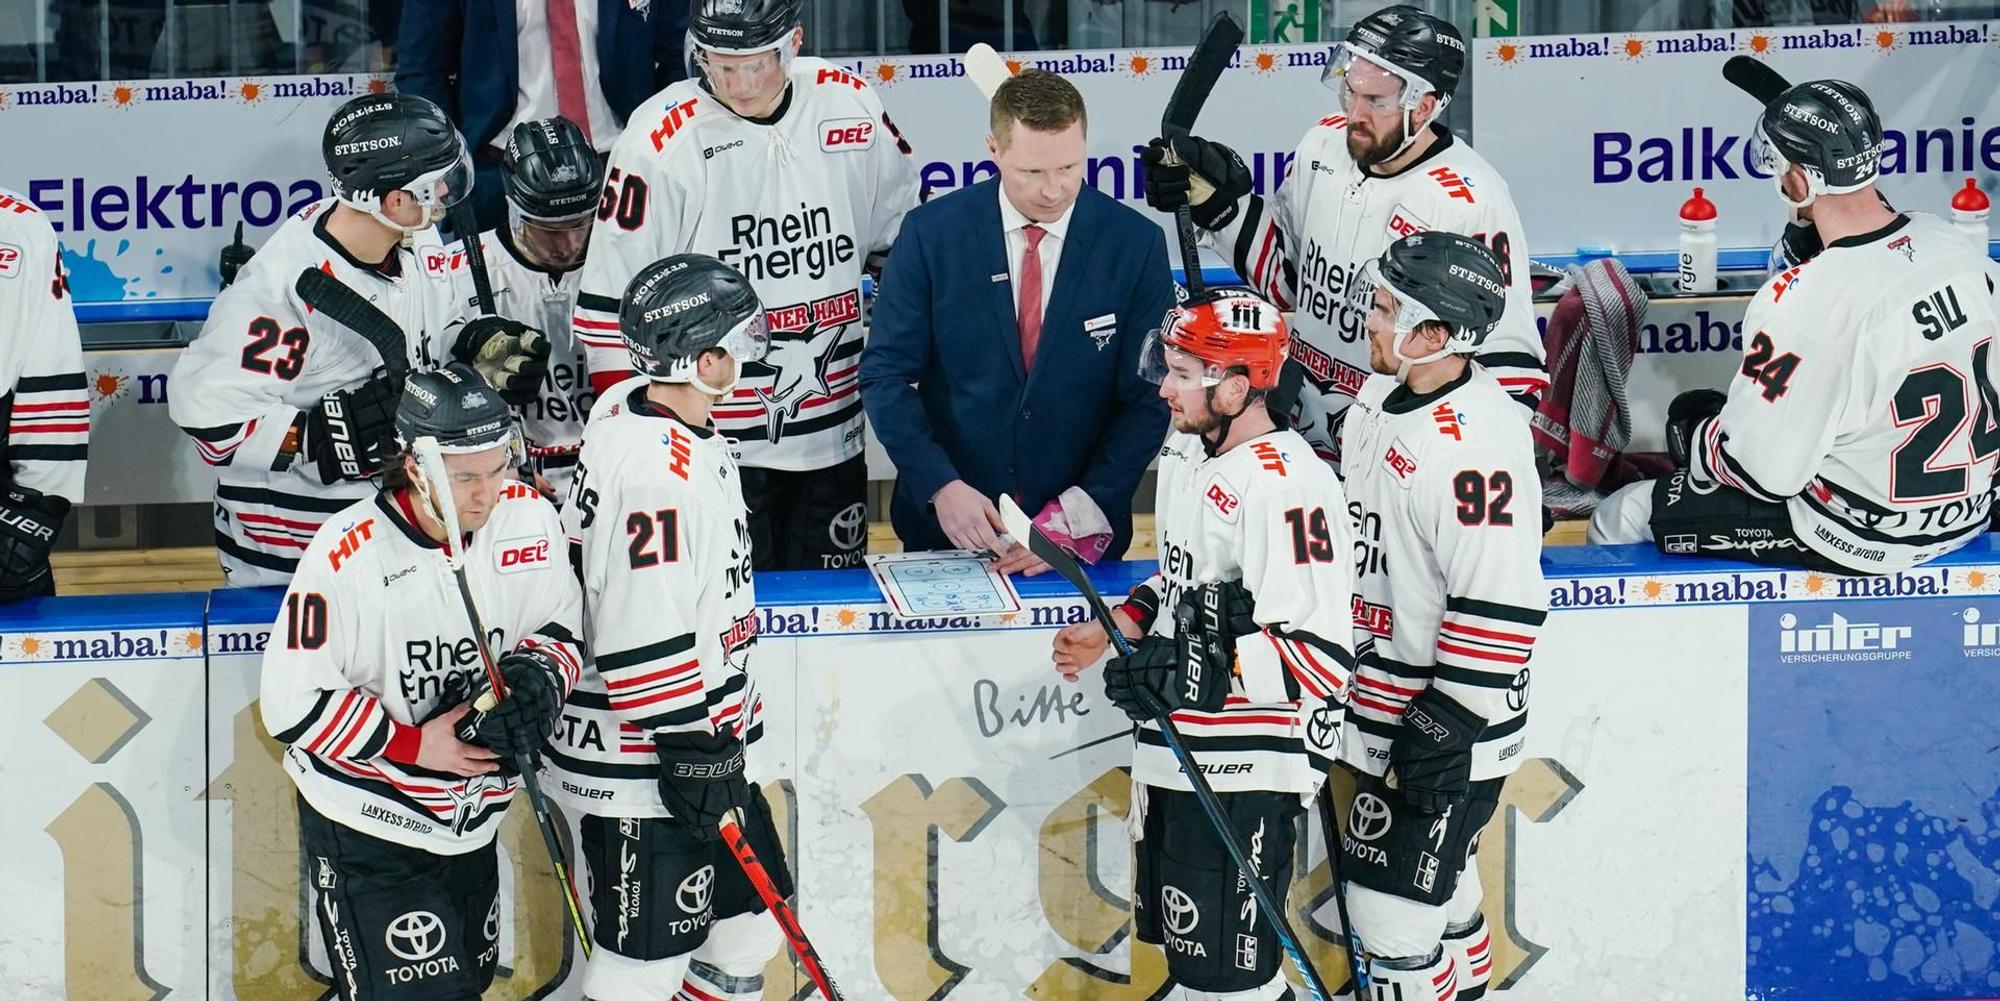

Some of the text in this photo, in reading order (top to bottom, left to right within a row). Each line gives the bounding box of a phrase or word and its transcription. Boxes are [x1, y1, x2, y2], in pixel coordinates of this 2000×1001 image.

[707, 26, 744, 37] STETSON
[1656, 33, 1735, 53] maba!
[1782, 29, 1862, 49] maba!
[1909, 25, 1989, 45] maba!
[1529, 37, 1609, 58] maba!
[816, 68, 867, 90] HIT
[910, 58, 967, 79] mab
[1035, 54, 1115, 74] maba!
[17, 85, 98, 105] maba!
[145, 81, 226, 102] maba!
[273, 77, 354, 97] maba!
[650, 98, 698, 153] HIT
[826, 122, 873, 146] DEL
[1784, 103, 1839, 134] STETSON.
[1428, 166, 1475, 205] HIT
[1855, 161, 1875, 180] 24
[732, 202, 831, 249] Rhein
[1390, 214, 1420, 238] DE
[719, 233, 855, 281] Energie
[1681, 252, 1697, 291] rgie
[769, 292, 860, 331] NER HAIE
[240, 315, 310, 381] 23
[1741, 329, 1803, 404] 24
[1433, 401, 1462, 441] HIT
[669, 427, 694, 481] HIT
[1250, 440, 1287, 477] HIT
[1385, 446, 1417, 480] DEL
[1207, 484, 1238, 515] DEL
[1453, 469, 1513, 526] 92
[328, 518, 375, 573] HIT
[626, 508, 679, 570] 21
[1285, 506, 1334, 565] 19
[1701, 535, 1808, 558] Supra
[1735, 528, 1774, 538] TOYOTA
[1815, 523, 1854, 553] LANXESS
[1853, 547, 1886, 562] arena
[501, 539, 550, 567] DEL
[1549, 579, 1626, 607] aba!
[1675, 573, 1787, 602] maba!
[1837, 568, 1949, 597] maba!
[287, 592, 328, 650] 10
[754, 607, 820, 635] aba!
[1780, 612, 1912, 652] inter
[54, 630, 168, 660] maba!
[406, 627, 504, 672] Rhen
[1781, 651, 1912, 664] VERSICHERUNGSGRUPPE
[973, 679, 1090, 738] Bitte
[361, 802, 404, 826] LANXESS
[612, 840, 637, 952] Supra
[630, 881, 641, 918] TOYOTA
[339, 928, 358, 970] TOYOTA
[385, 955, 460, 985] TOYOTA
